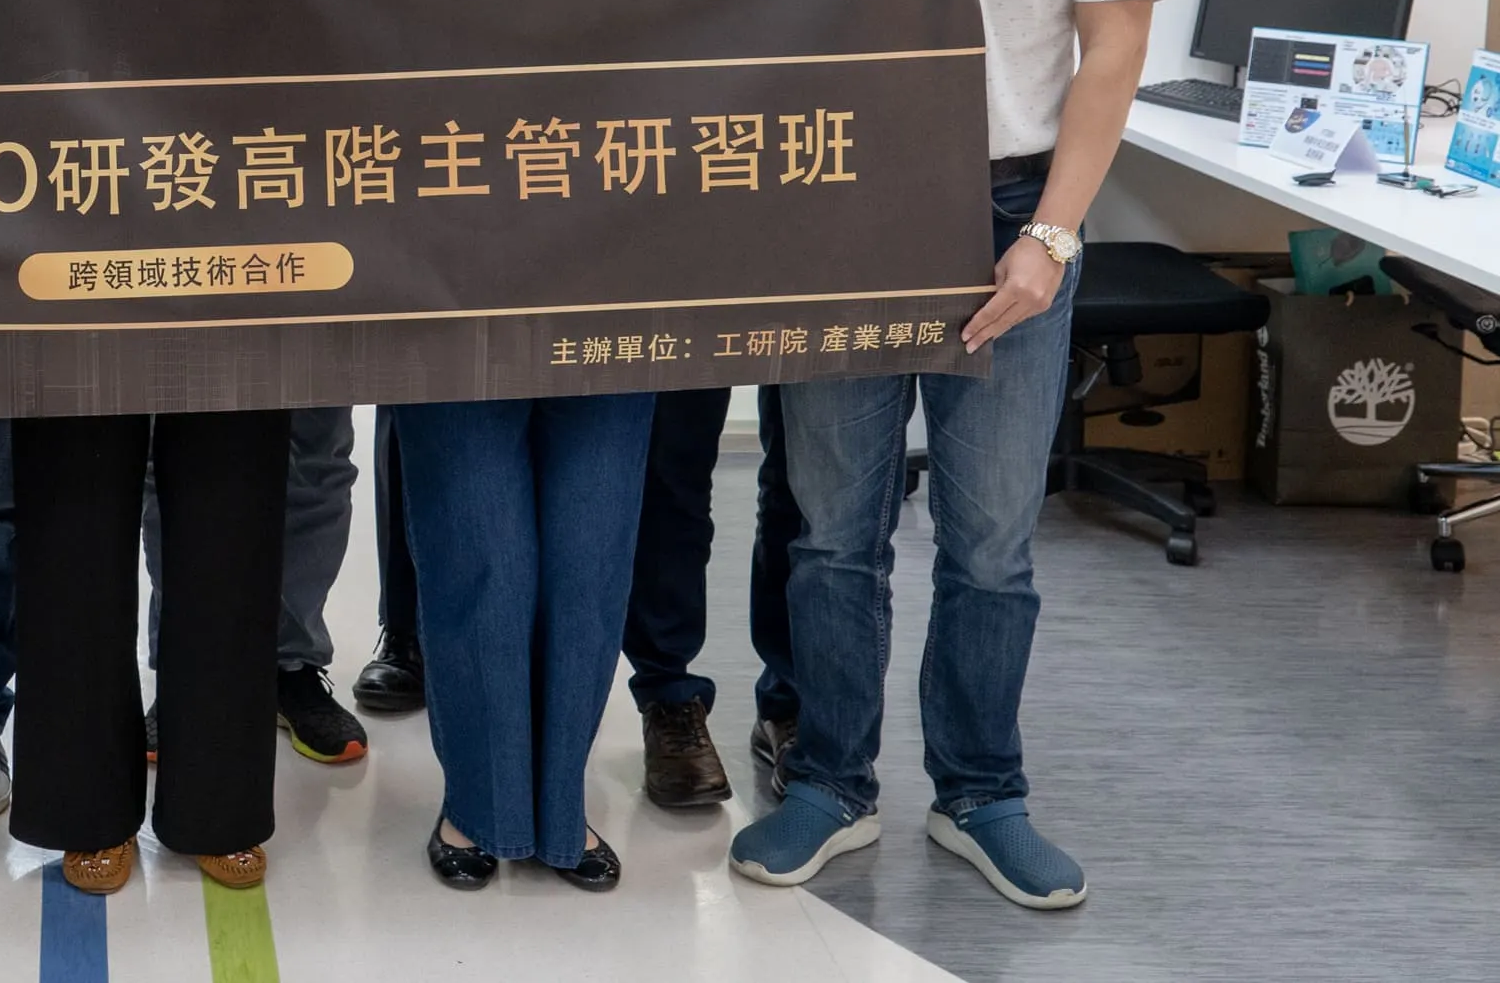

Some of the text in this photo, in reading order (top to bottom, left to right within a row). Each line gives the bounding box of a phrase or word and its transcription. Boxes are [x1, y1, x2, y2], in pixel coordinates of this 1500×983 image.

[68, 251, 306, 292] 跨領域技術合作
[713, 328, 808, 358] 工研院
[820, 320, 947, 354] 產業學院
